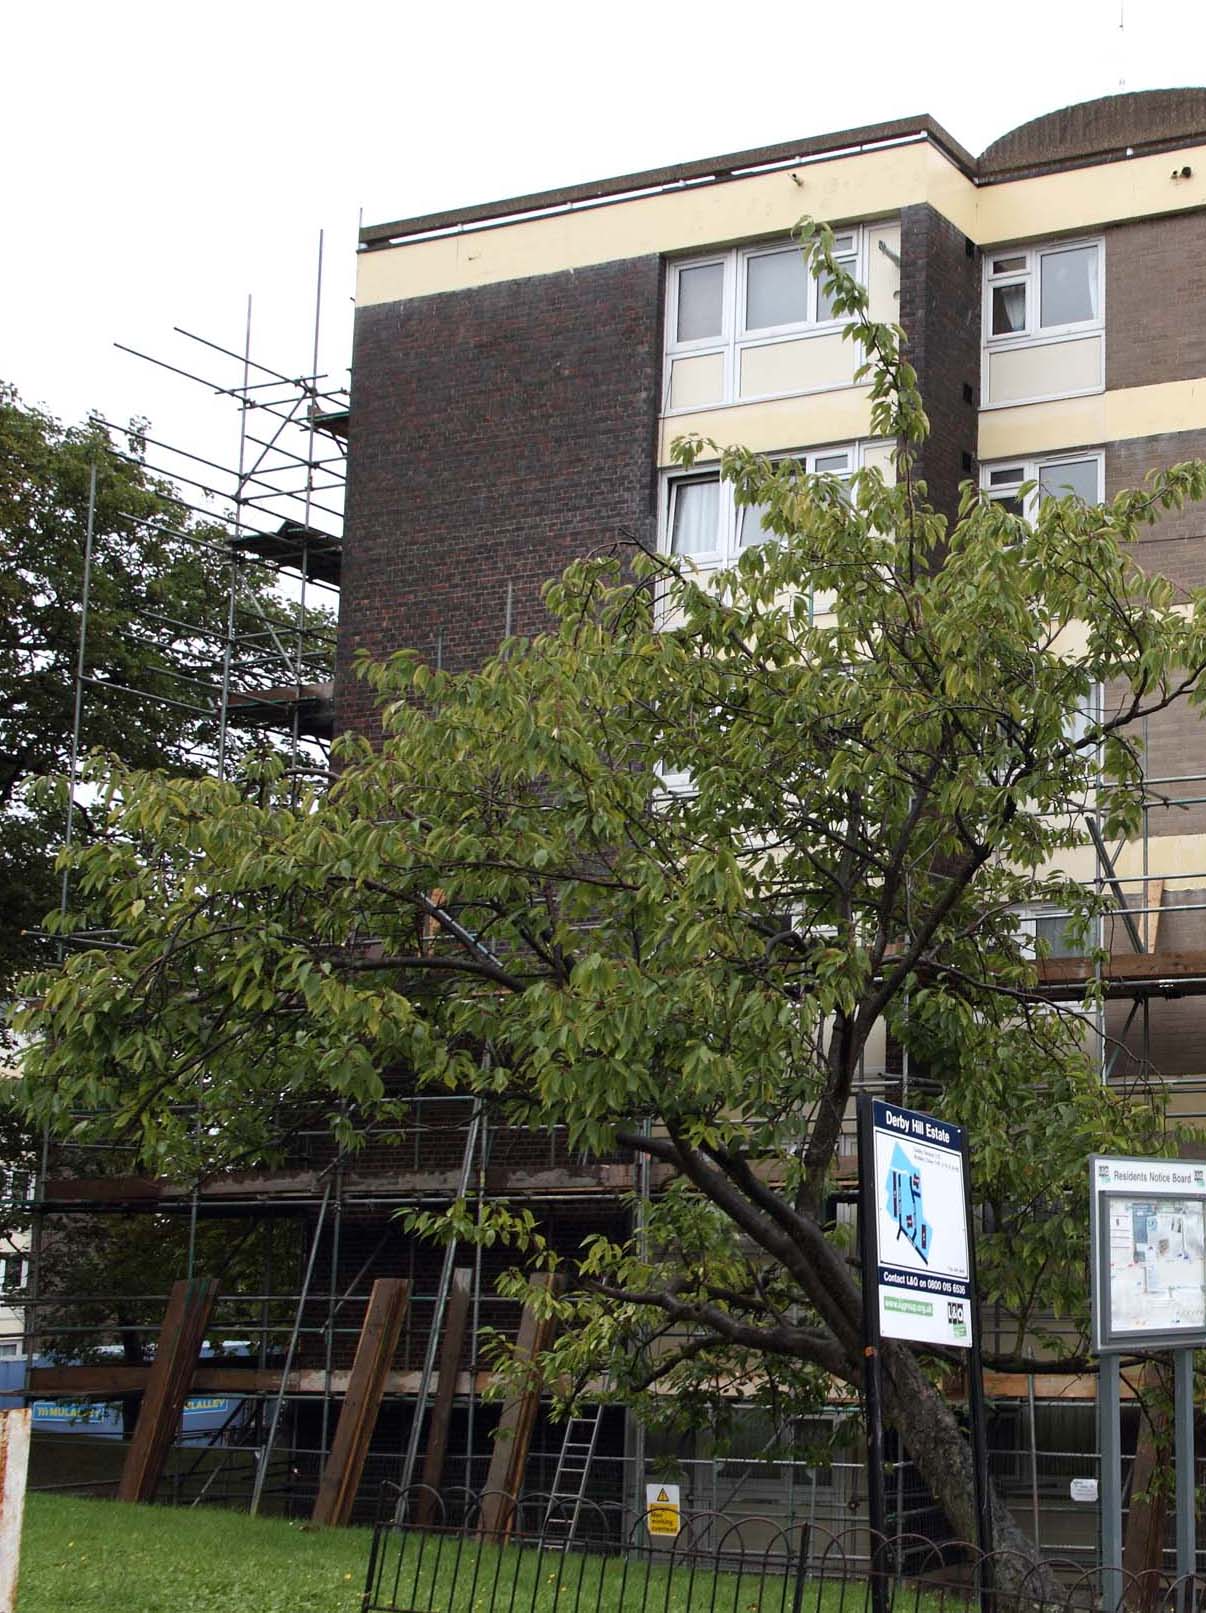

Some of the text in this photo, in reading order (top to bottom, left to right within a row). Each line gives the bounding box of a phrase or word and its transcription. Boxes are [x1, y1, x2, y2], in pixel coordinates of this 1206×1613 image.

[885, 1110, 950, 1143] Derby Hill Estate
[1114, 1170, 1147, 1182] Residents
[1149, 1172, 1170, 1183] Notice
[1172, 1173, 1192, 1184] Board
[883, 1271, 906, 1285] Contact
[906, 1275, 919, 1287] L&Q
[919, 1280, 927, 1288] on
[947, 1303, 964, 1324] L&Q
